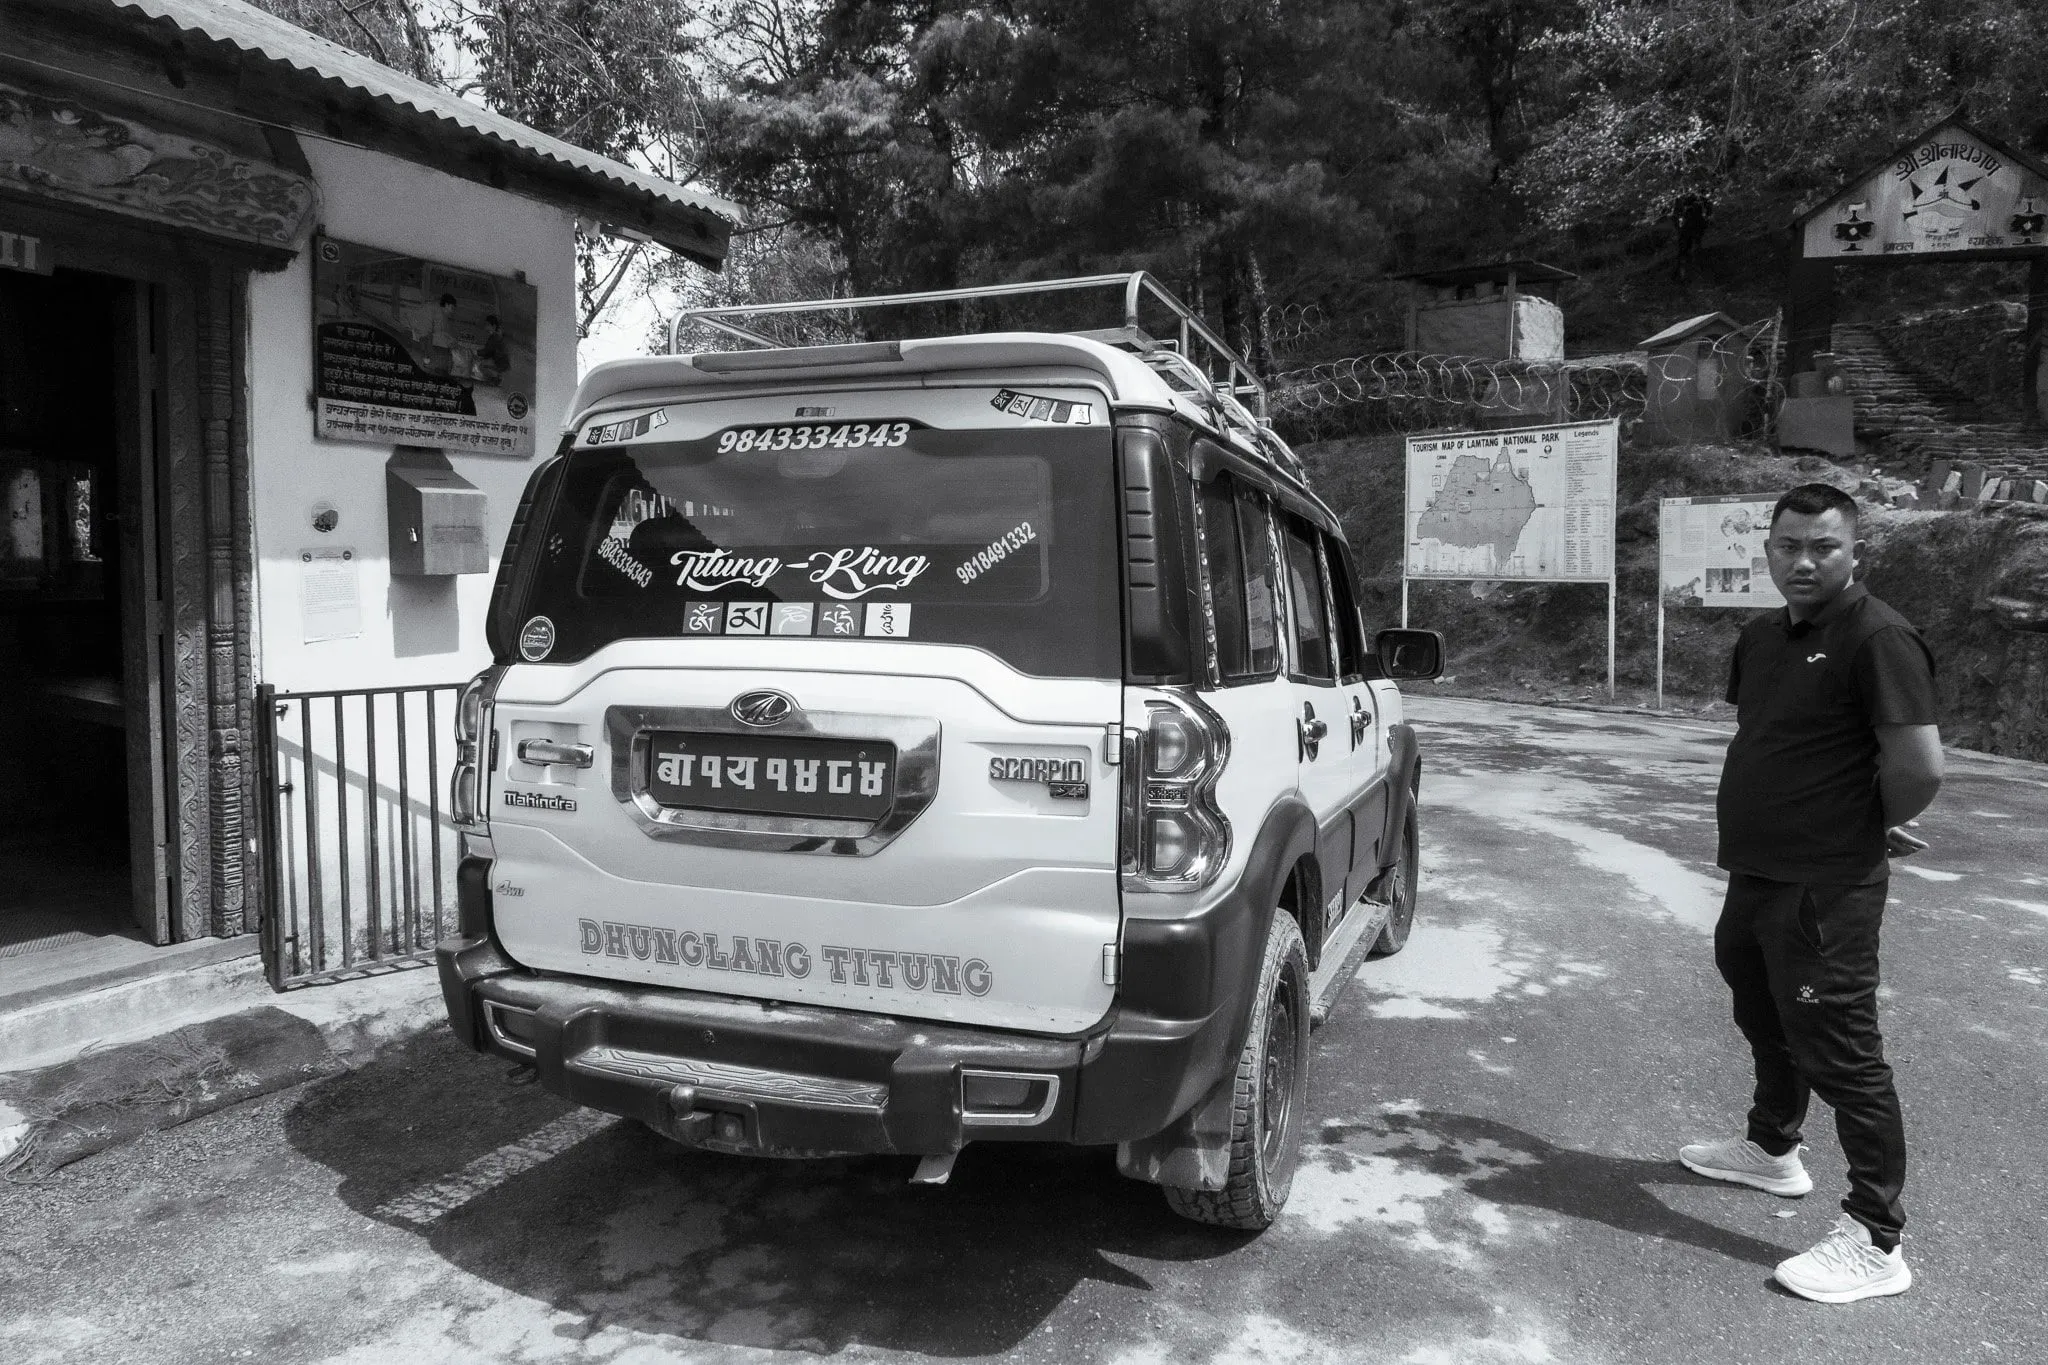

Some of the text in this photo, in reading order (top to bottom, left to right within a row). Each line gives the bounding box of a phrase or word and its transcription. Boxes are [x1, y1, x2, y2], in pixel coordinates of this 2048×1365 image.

[717, 423, 911, 454] 9843334343
[1412, 442, 1438, 453] TOURISM
[1442, 441, 1455, 451] MAP
[1457, 440, 1464, 449] OF
[1503, 435, 1537, 446] NATIONAL
[1541, 432, 1560, 442] PARK
[1574, 430, 1599, 438] Legends
[598, 537, 653, 588] 9843334343
[956, 521, 1036, 585] 9818491332
[990, 757, 1085, 783] SCORPIO
[504, 790, 577, 812] Mahindra
[579, 918, 993, 997] DHUNGLANG TITUNG
